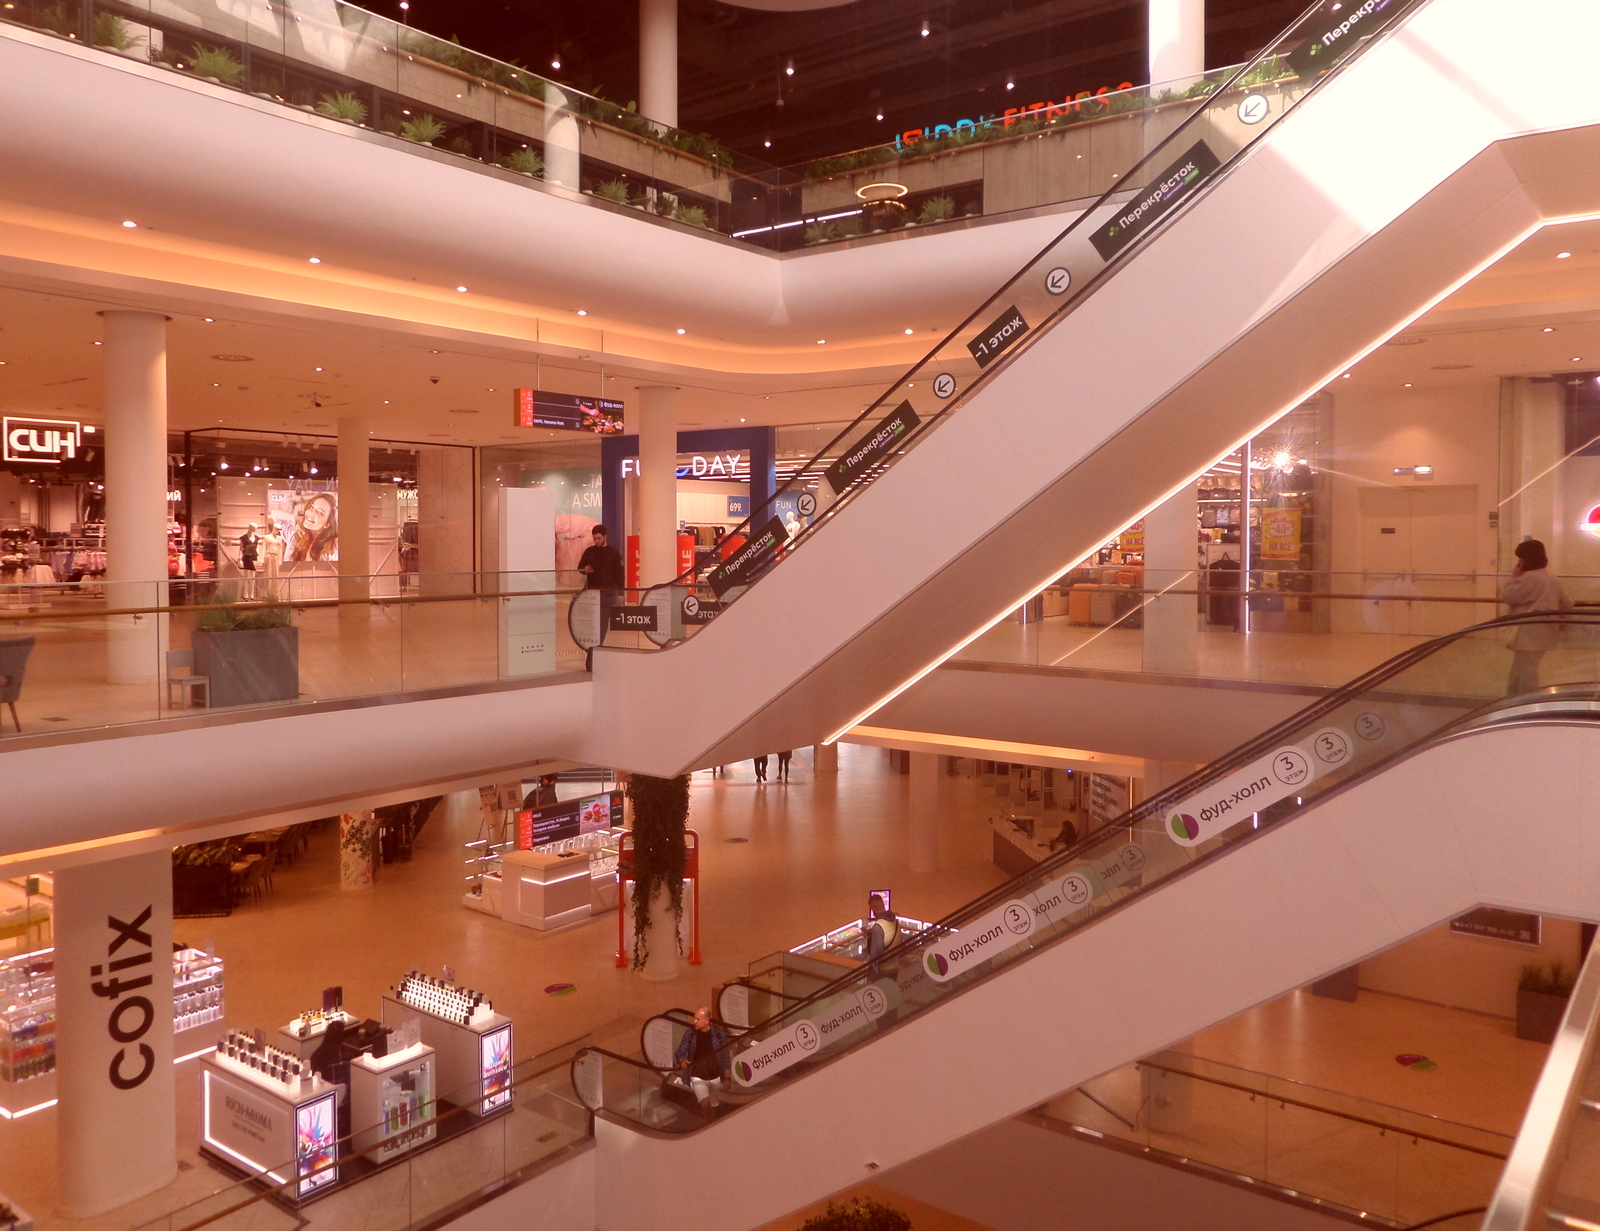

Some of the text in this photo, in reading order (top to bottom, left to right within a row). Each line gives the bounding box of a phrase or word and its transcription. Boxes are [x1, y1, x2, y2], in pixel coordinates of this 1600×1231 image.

[1119, 161, 1196, 229] Перекрёсток
[975, 315, 1023, 358] -1 этаж
[846, 417, 902, 467] Перекрёсток
[692, 454, 741, 476] DAY
[776, 500, 791, 509] FUN
[725, 530, 773, 575] Перекрёсток
[616, 613, 651, 624] -1 этаж
[1362, 716, 1373, 729] 3
[1321, 737, 1333, 750] 3
[1325, 747, 1344, 761] этаж
[1280, 756, 1294, 771] 3
[1284, 768, 1305, 783] этаж
[1200, 777, 1272, 822] фуд-холл
[1128, 849, 1136, 860] 3
[1068, 880, 1078, 892] 3
[1071, 891, 1086, 902] этаж
[1009, 909, 1020, 922] 3
[1013, 920, 1029, 932] этаж
[949, 925, 1004, 962] фуд-холл
[91, 904, 155, 1090] cofix
[867, 992, 875, 1003] 3
[820, 1005, 863, 1035] фуд-холл
[800, 1028, 809, 1039] 3
[752, 1040, 796, 1071] фуд-холл
